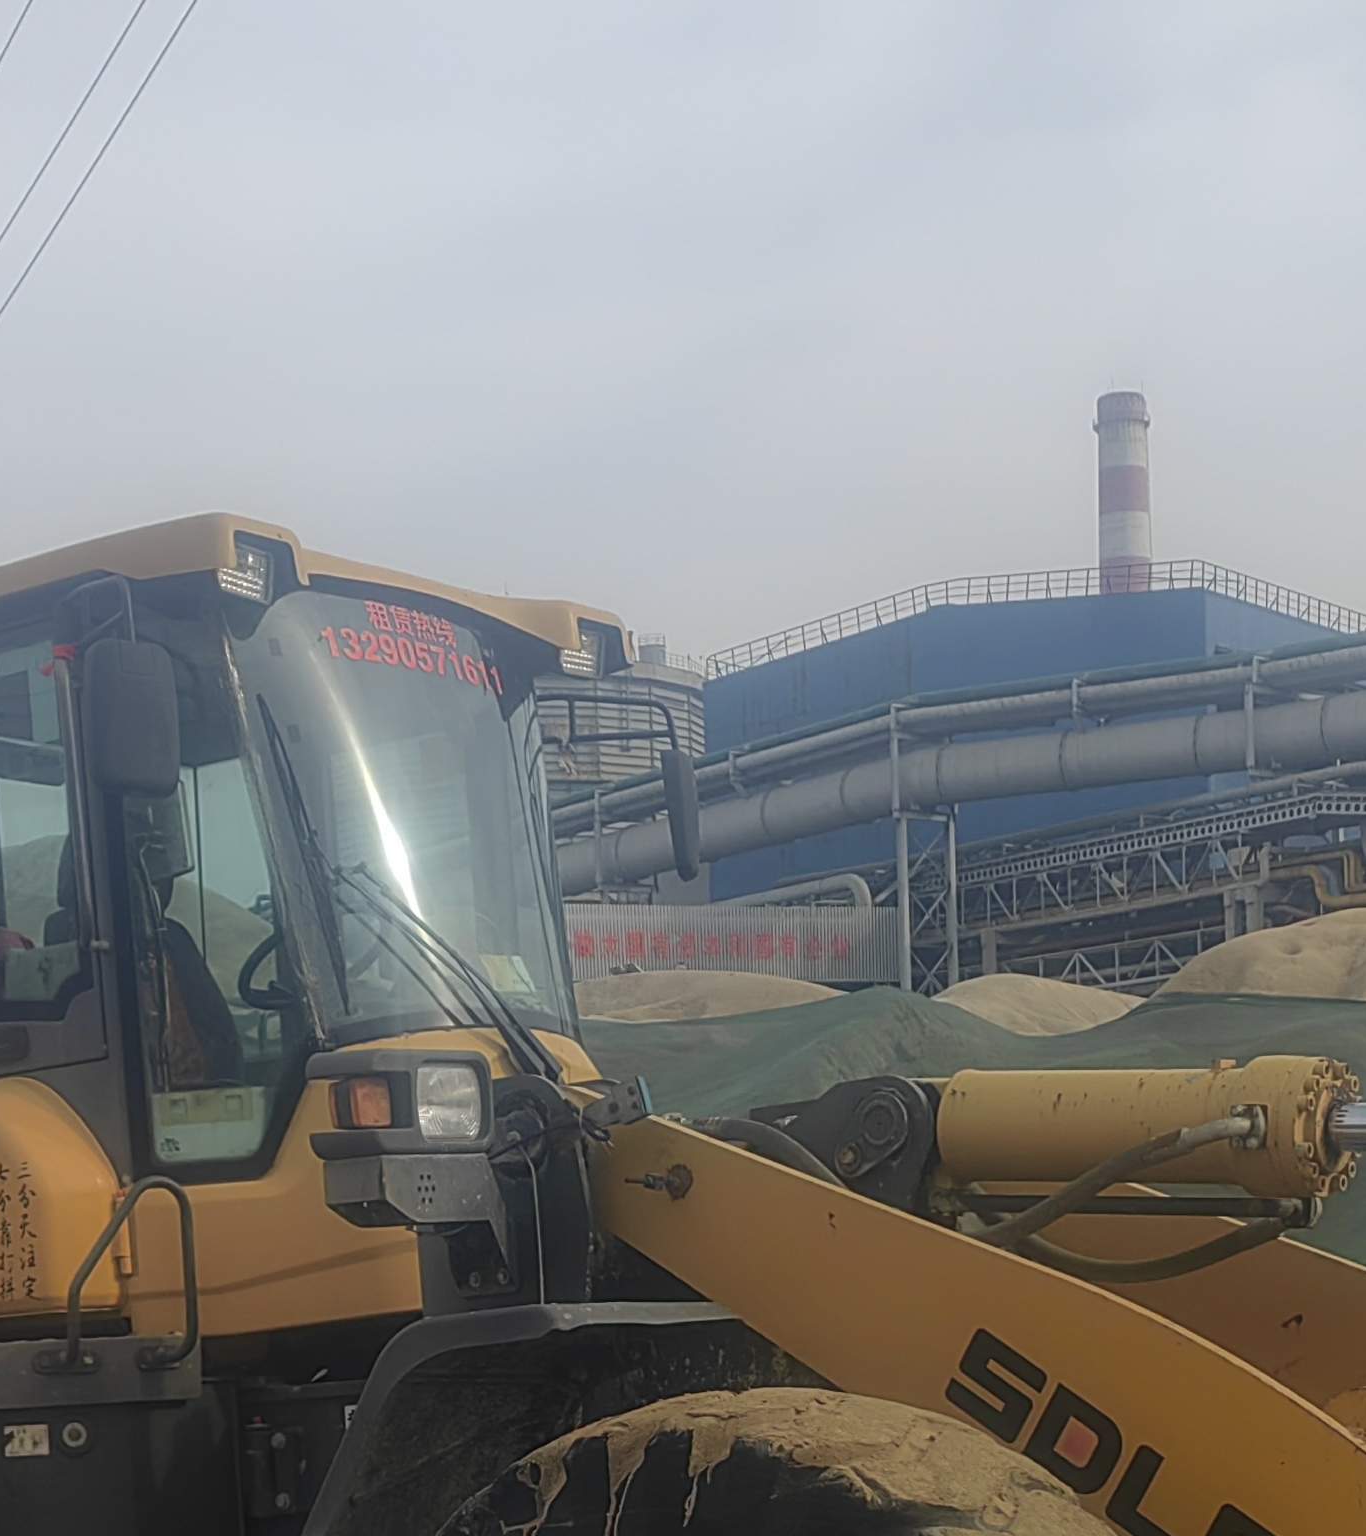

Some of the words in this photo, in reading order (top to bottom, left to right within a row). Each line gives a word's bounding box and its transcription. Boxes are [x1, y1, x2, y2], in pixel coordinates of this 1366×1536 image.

[364, 600, 457, 648] 租赁热线
[320, 626, 504, 696] 13290571611
[16, 1160, 42, 1302] 三分天注定
